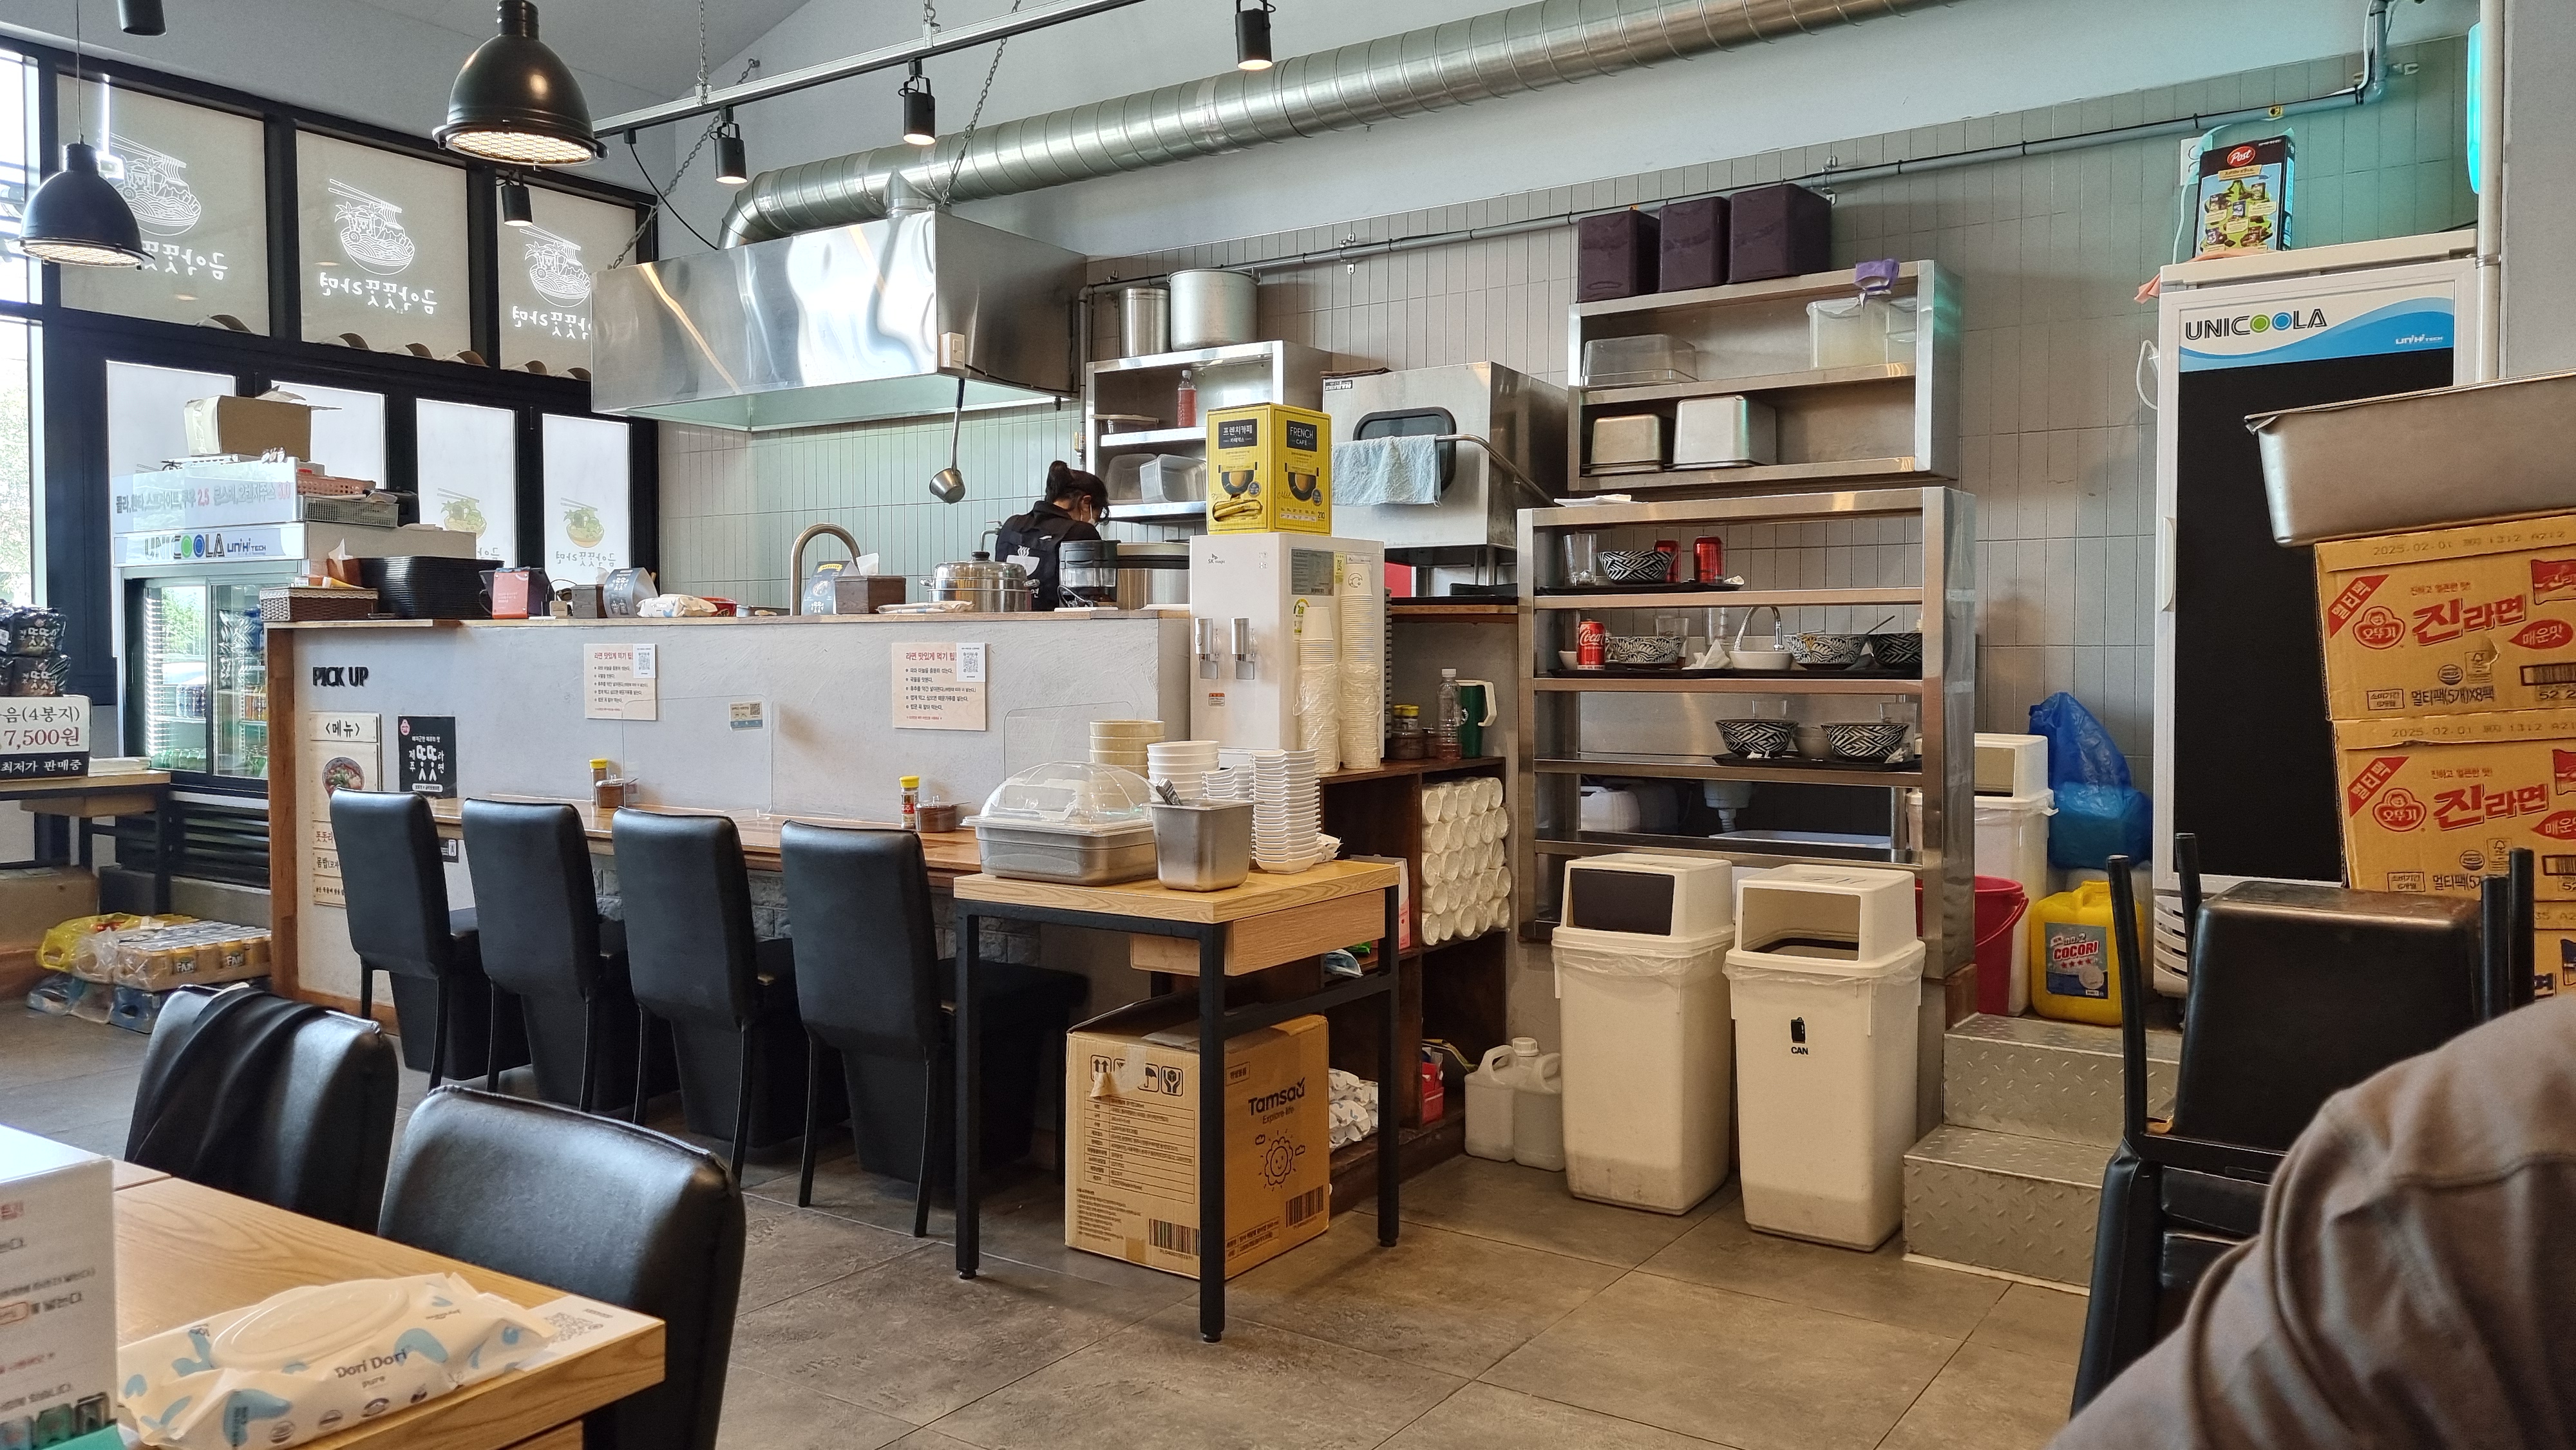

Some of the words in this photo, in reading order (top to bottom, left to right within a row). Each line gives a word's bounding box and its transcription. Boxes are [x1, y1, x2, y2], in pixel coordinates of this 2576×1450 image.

[2231, 149, 2252, 164] Post
[2185, 308, 2327, 341] UNICOOLA
[1222, 424, 1253, 436] 프렌치카페
[1290, 427, 1313, 440] FRENCH
[2331, 580, 2372, 621] 멀티팩
[2412, 594, 2526, 646] 진라면
[2362, 627, 2397, 641] 오뚜기
[2522, 623, 2564, 646] 매운맛
[905, 652, 917, 661] 라면
[918, 652, 935, 661] 맛있게
[936, 652, 948, 661] 먹기
[312, 667, 346, 687] PICK
[348, 667, 369, 687] UP
[0, 706, 80, 723] 음(4봉지)
[4, 726, 80, 750] 7,500원
[1, 760, 37, 774] 최저가
[44, 758, 82, 772] 판매중
[2383, 809, 2417, 822] 오뚜기
[2434, 783, 2550, 831] 진라면
[2054, 941, 2099, 961] COCORI
[1791, 1046, 1809, 1056] CAN
[1262, 1109, 1285, 1125] Explore
[1285, 1106, 1294, 1116] life
[334, 1360, 368, 1379] Dori
[370, 1348, 407, 1369] Dori
